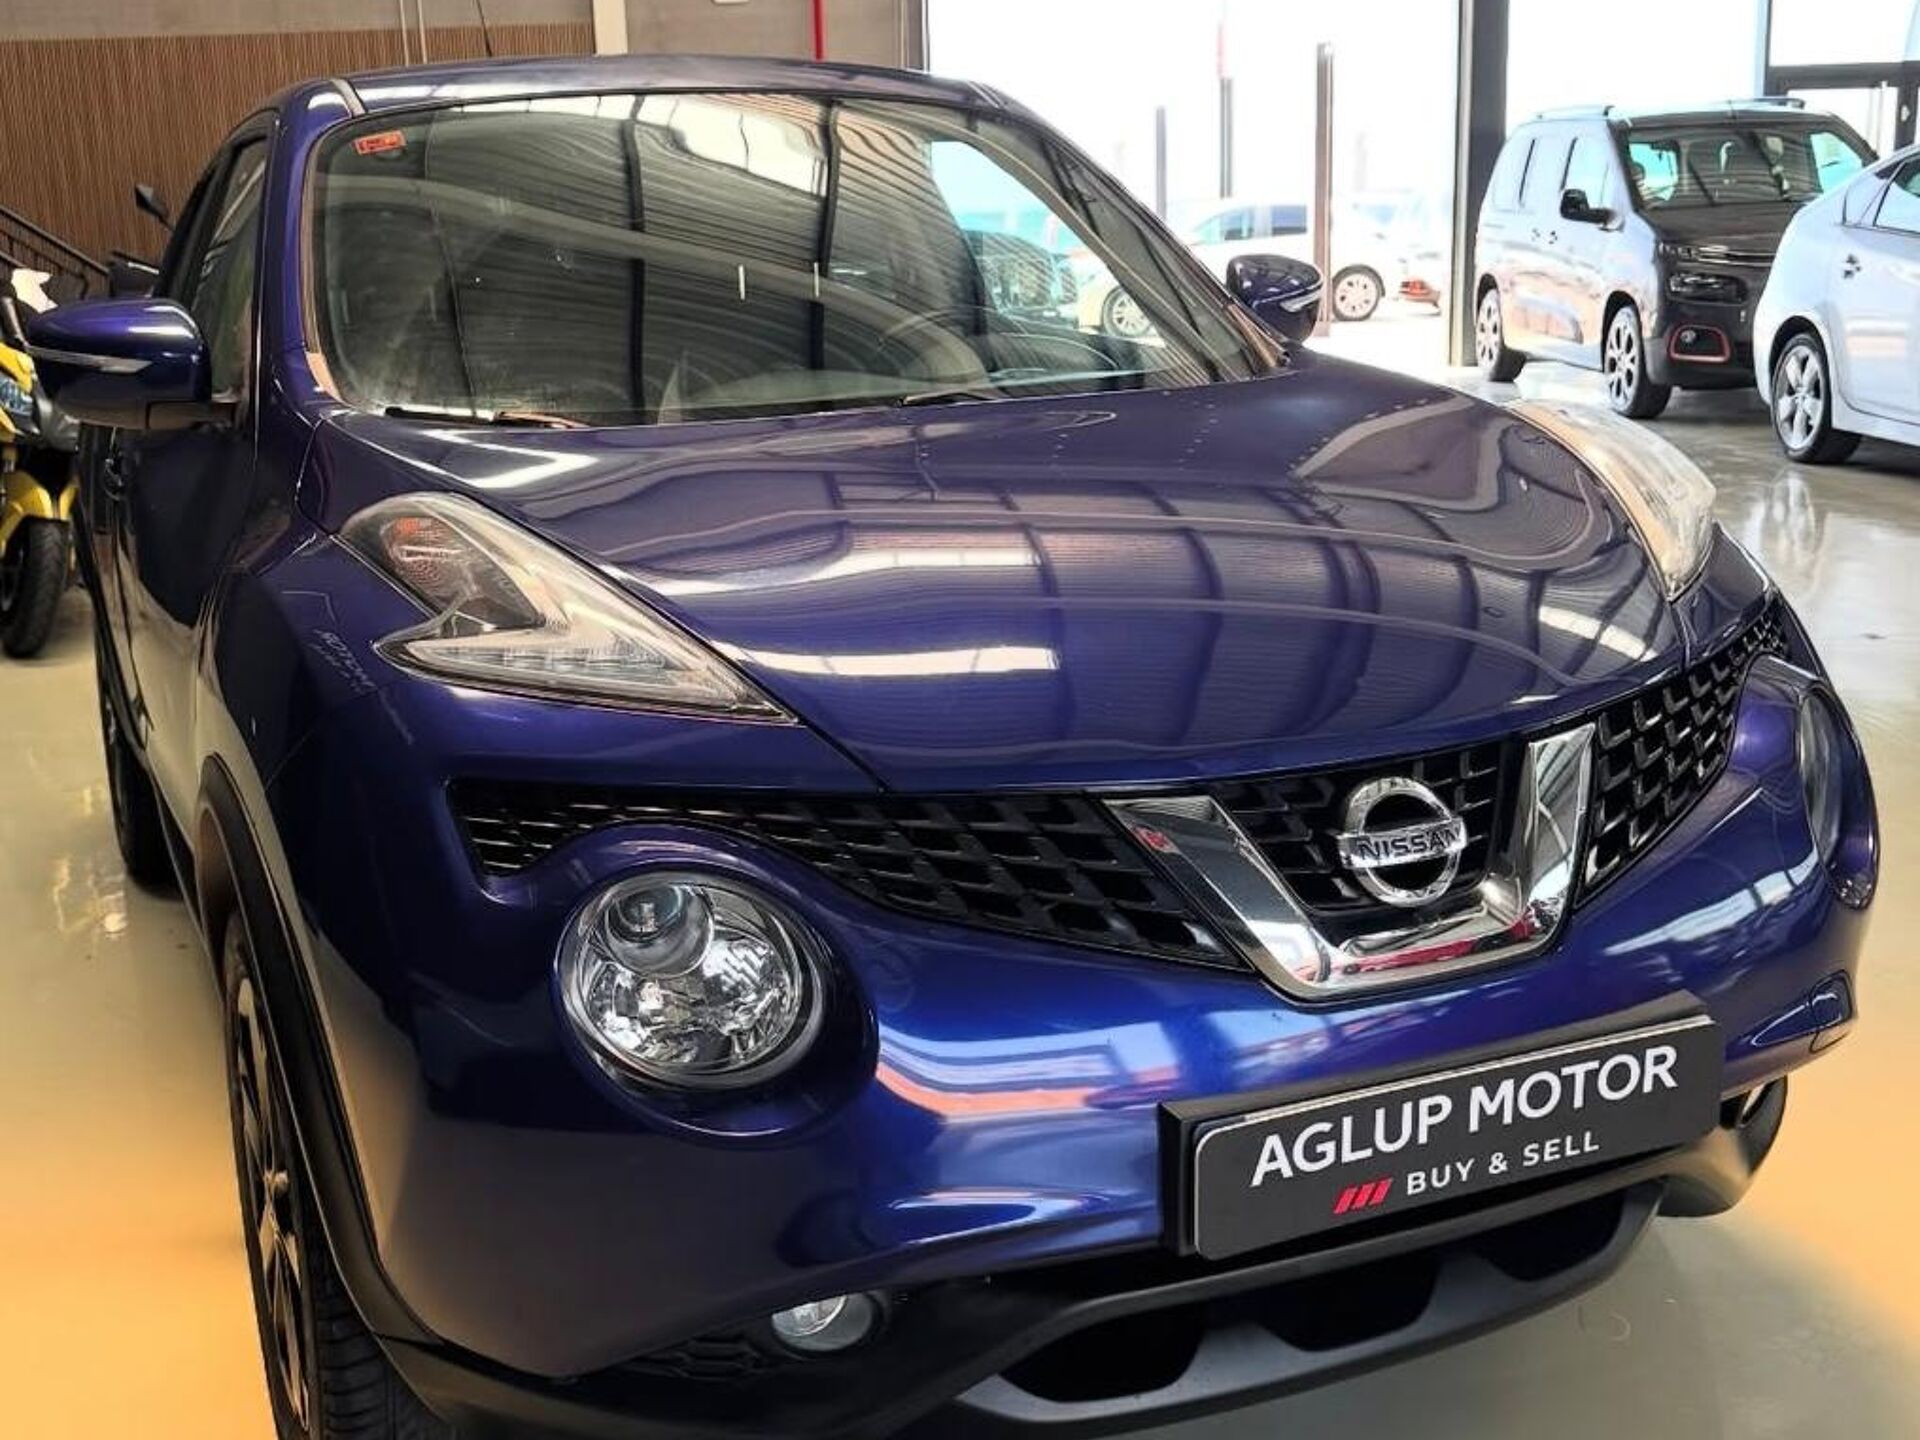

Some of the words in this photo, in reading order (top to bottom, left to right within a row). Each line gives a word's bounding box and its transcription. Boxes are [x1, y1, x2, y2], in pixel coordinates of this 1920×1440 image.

[1359, 825, 1460, 860] NISSAN
[1250, 1096, 1452, 1186] AGLUP
[1469, 1045, 1677, 1132] MOTOR
[1406, 1157, 1475, 1196] BUY
[1488, 1151, 1508, 1175] &
[1523, 1130, 1600, 1166] SELL
